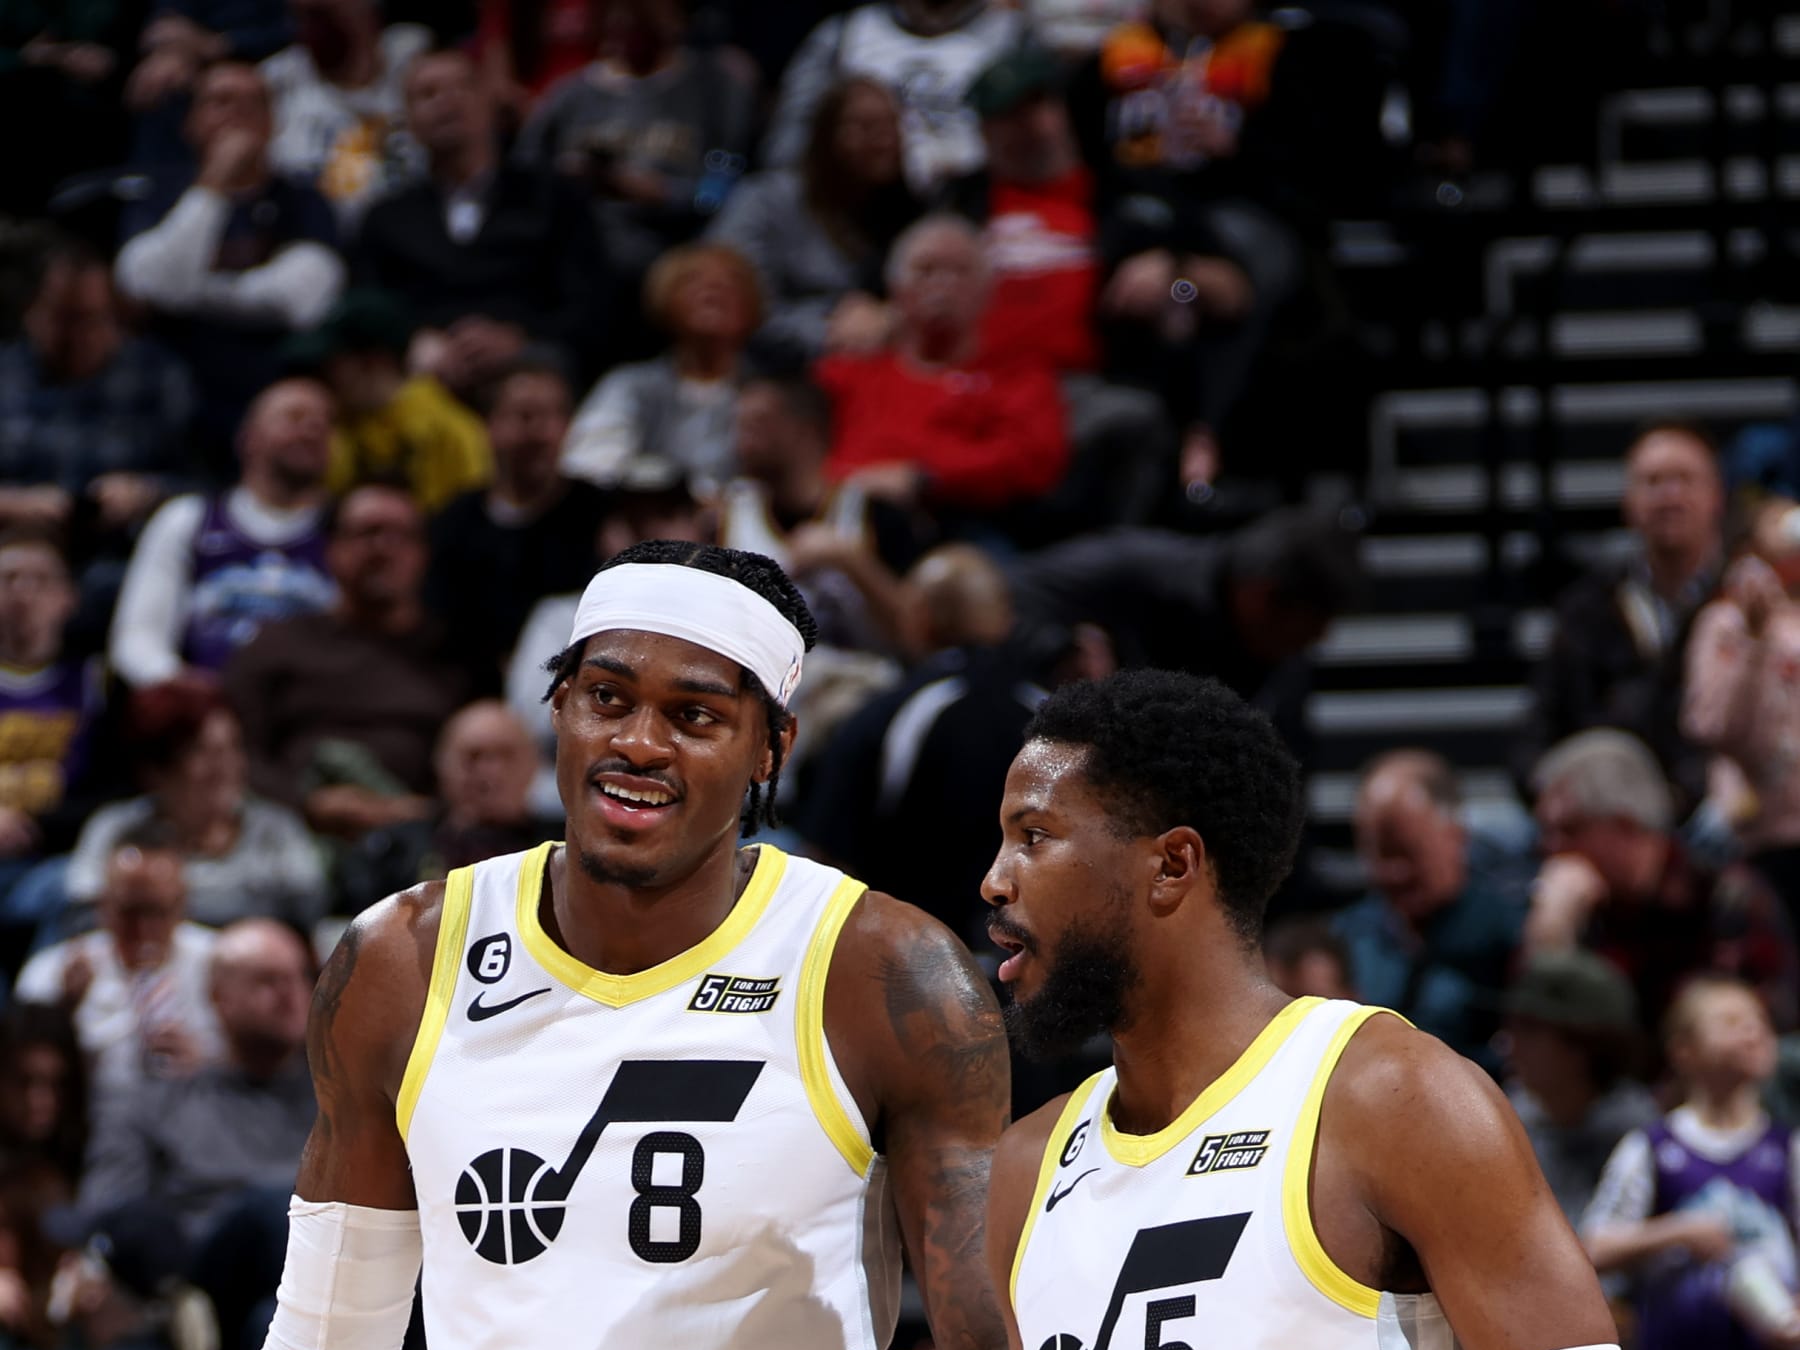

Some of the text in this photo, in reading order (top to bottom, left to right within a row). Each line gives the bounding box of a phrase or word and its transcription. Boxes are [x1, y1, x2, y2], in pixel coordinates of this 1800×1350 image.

[478, 940, 507, 977] 6
[695, 977, 725, 1009] 5
[733, 980, 773, 991] FOR THE
[721, 995, 775, 1011] FIGHT
[1228, 1133, 1265, 1145] FOR THE
[1193, 1138, 1223, 1172] 5
[1214, 1149, 1264, 1168] FIGHT
[628, 1131, 705, 1263] 8
